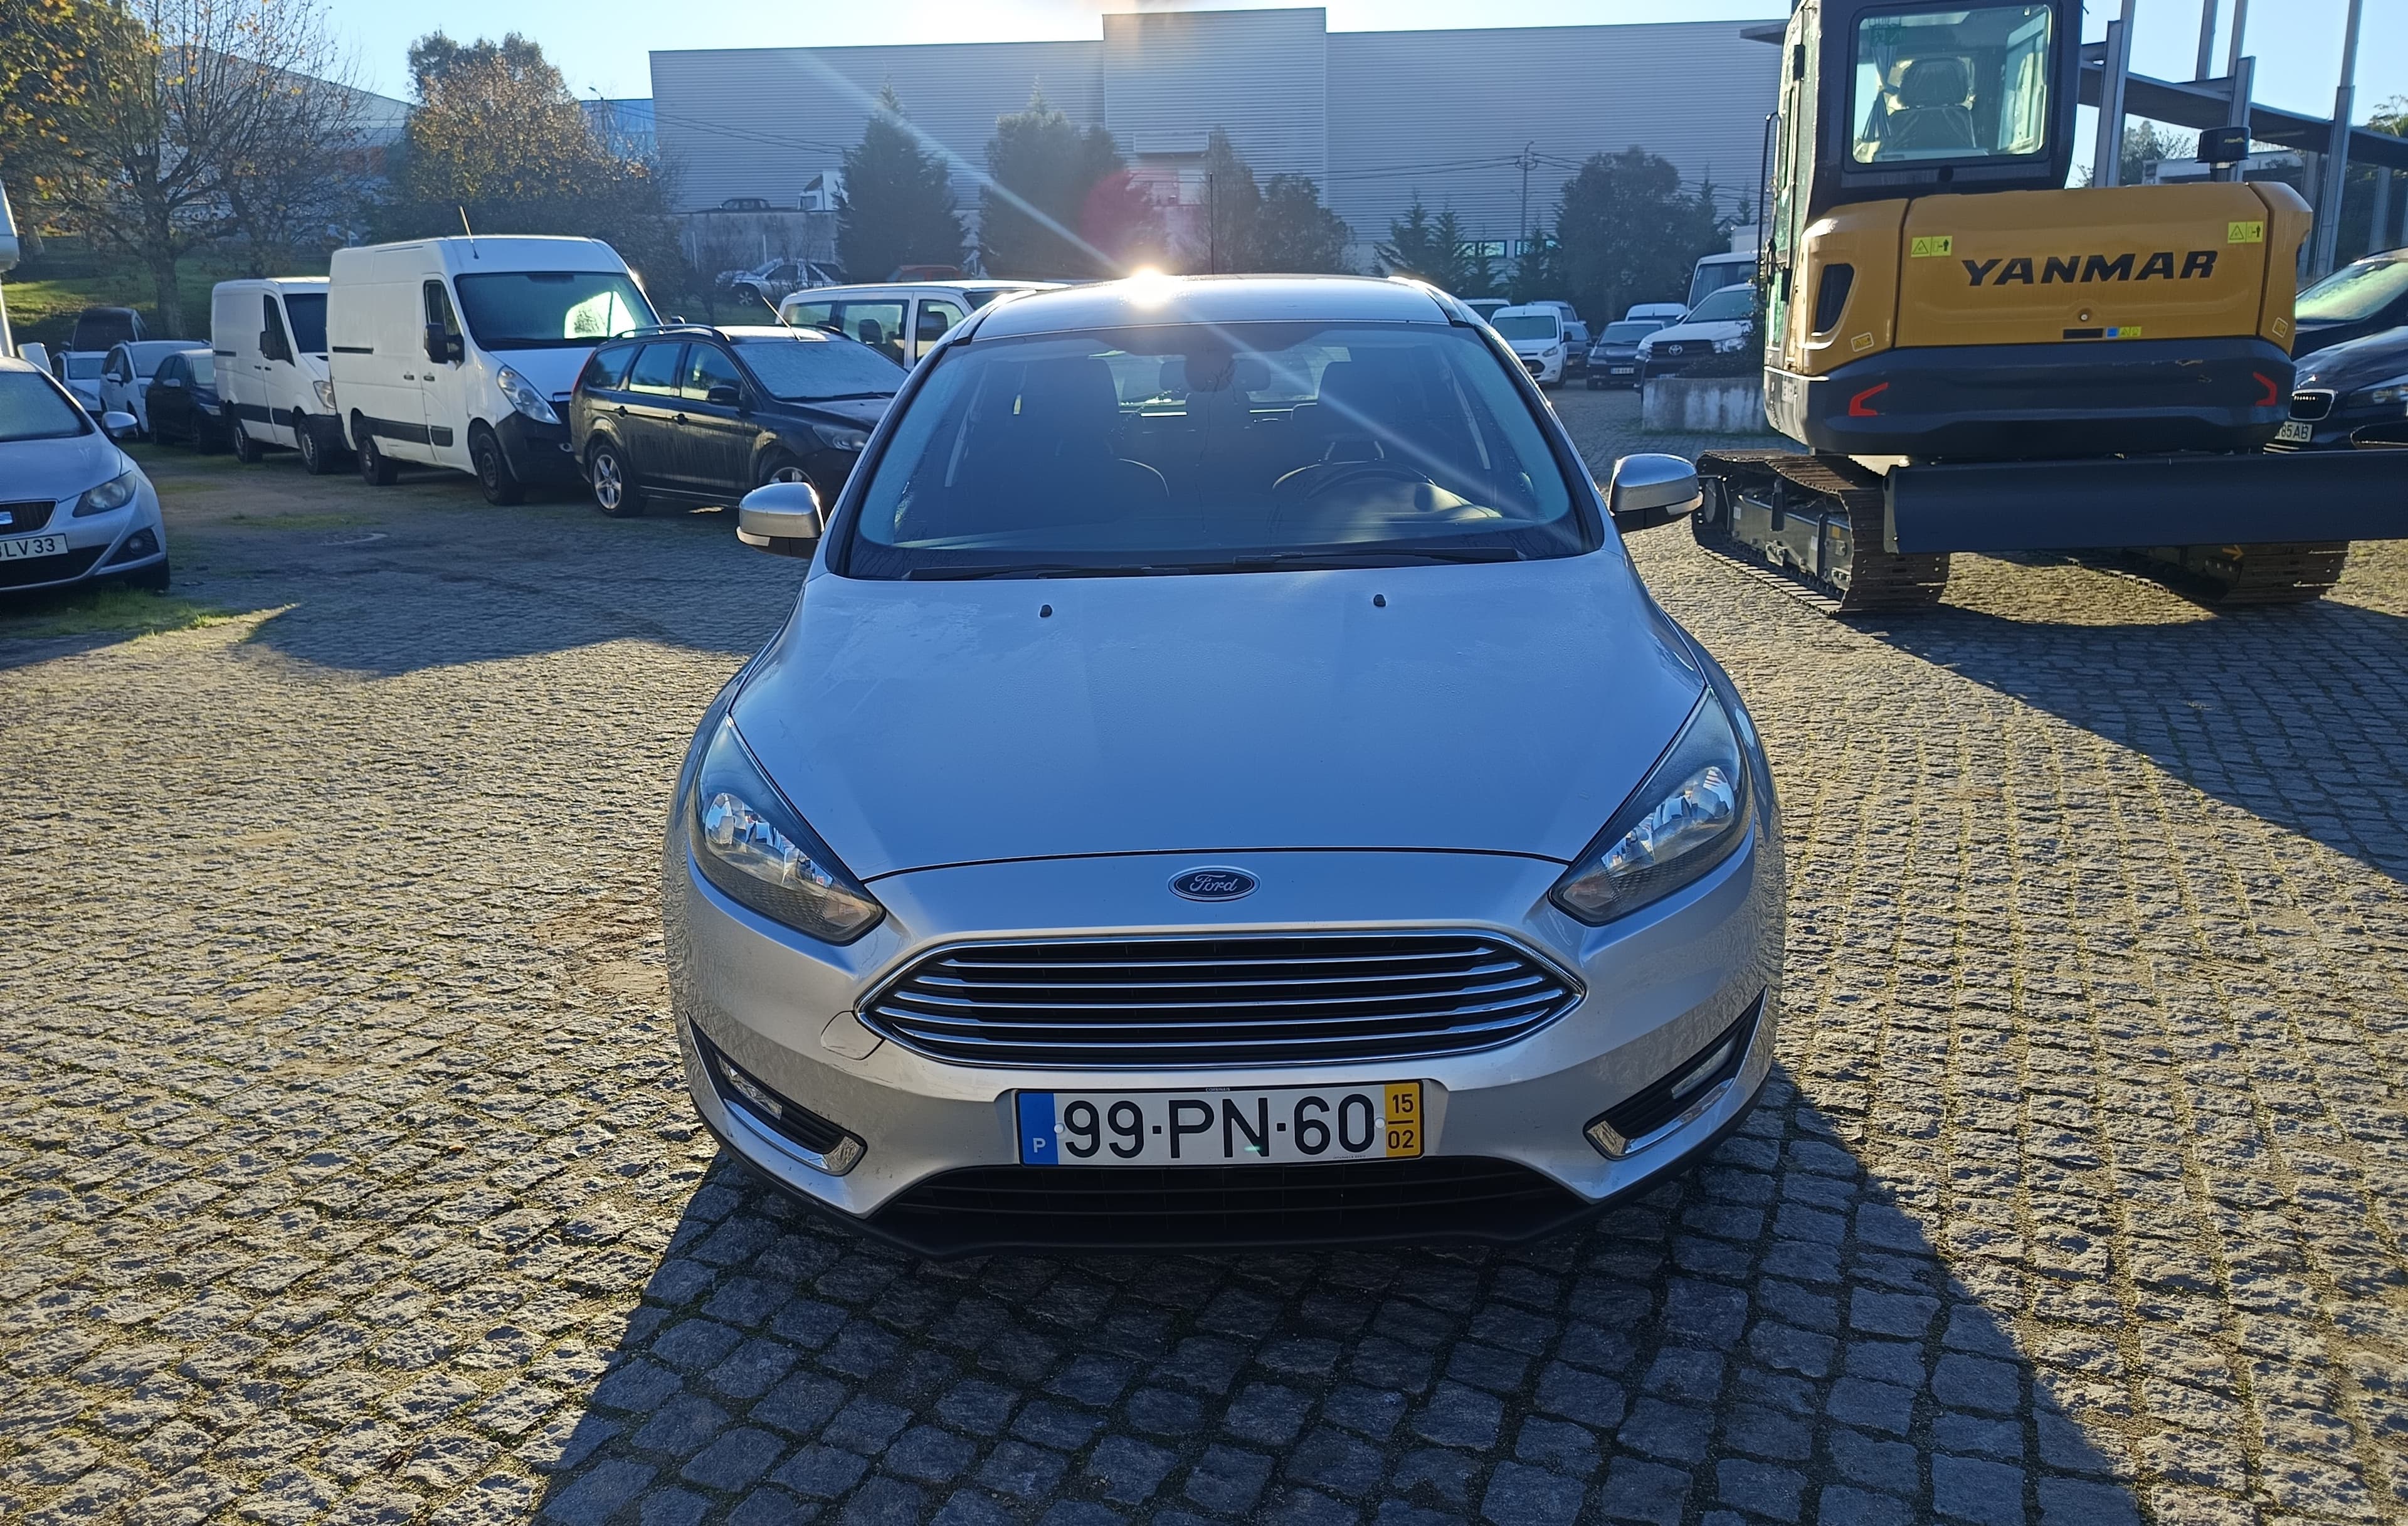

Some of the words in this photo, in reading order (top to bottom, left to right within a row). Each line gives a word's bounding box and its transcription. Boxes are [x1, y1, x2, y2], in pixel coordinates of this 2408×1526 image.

[1962, 251, 2218, 287] YANMAR
[2292, 425, 2308, 440] AB
[4, 540, 28, 558] LV
[33, 538, 55, 554] 33
[1189, 874, 1238, 892] Ford
[1392, 1094, 1414, 1114] 15
[1033, 1138, 1046, 1153] P
[1388, 1130, 1414, 1149] 02
